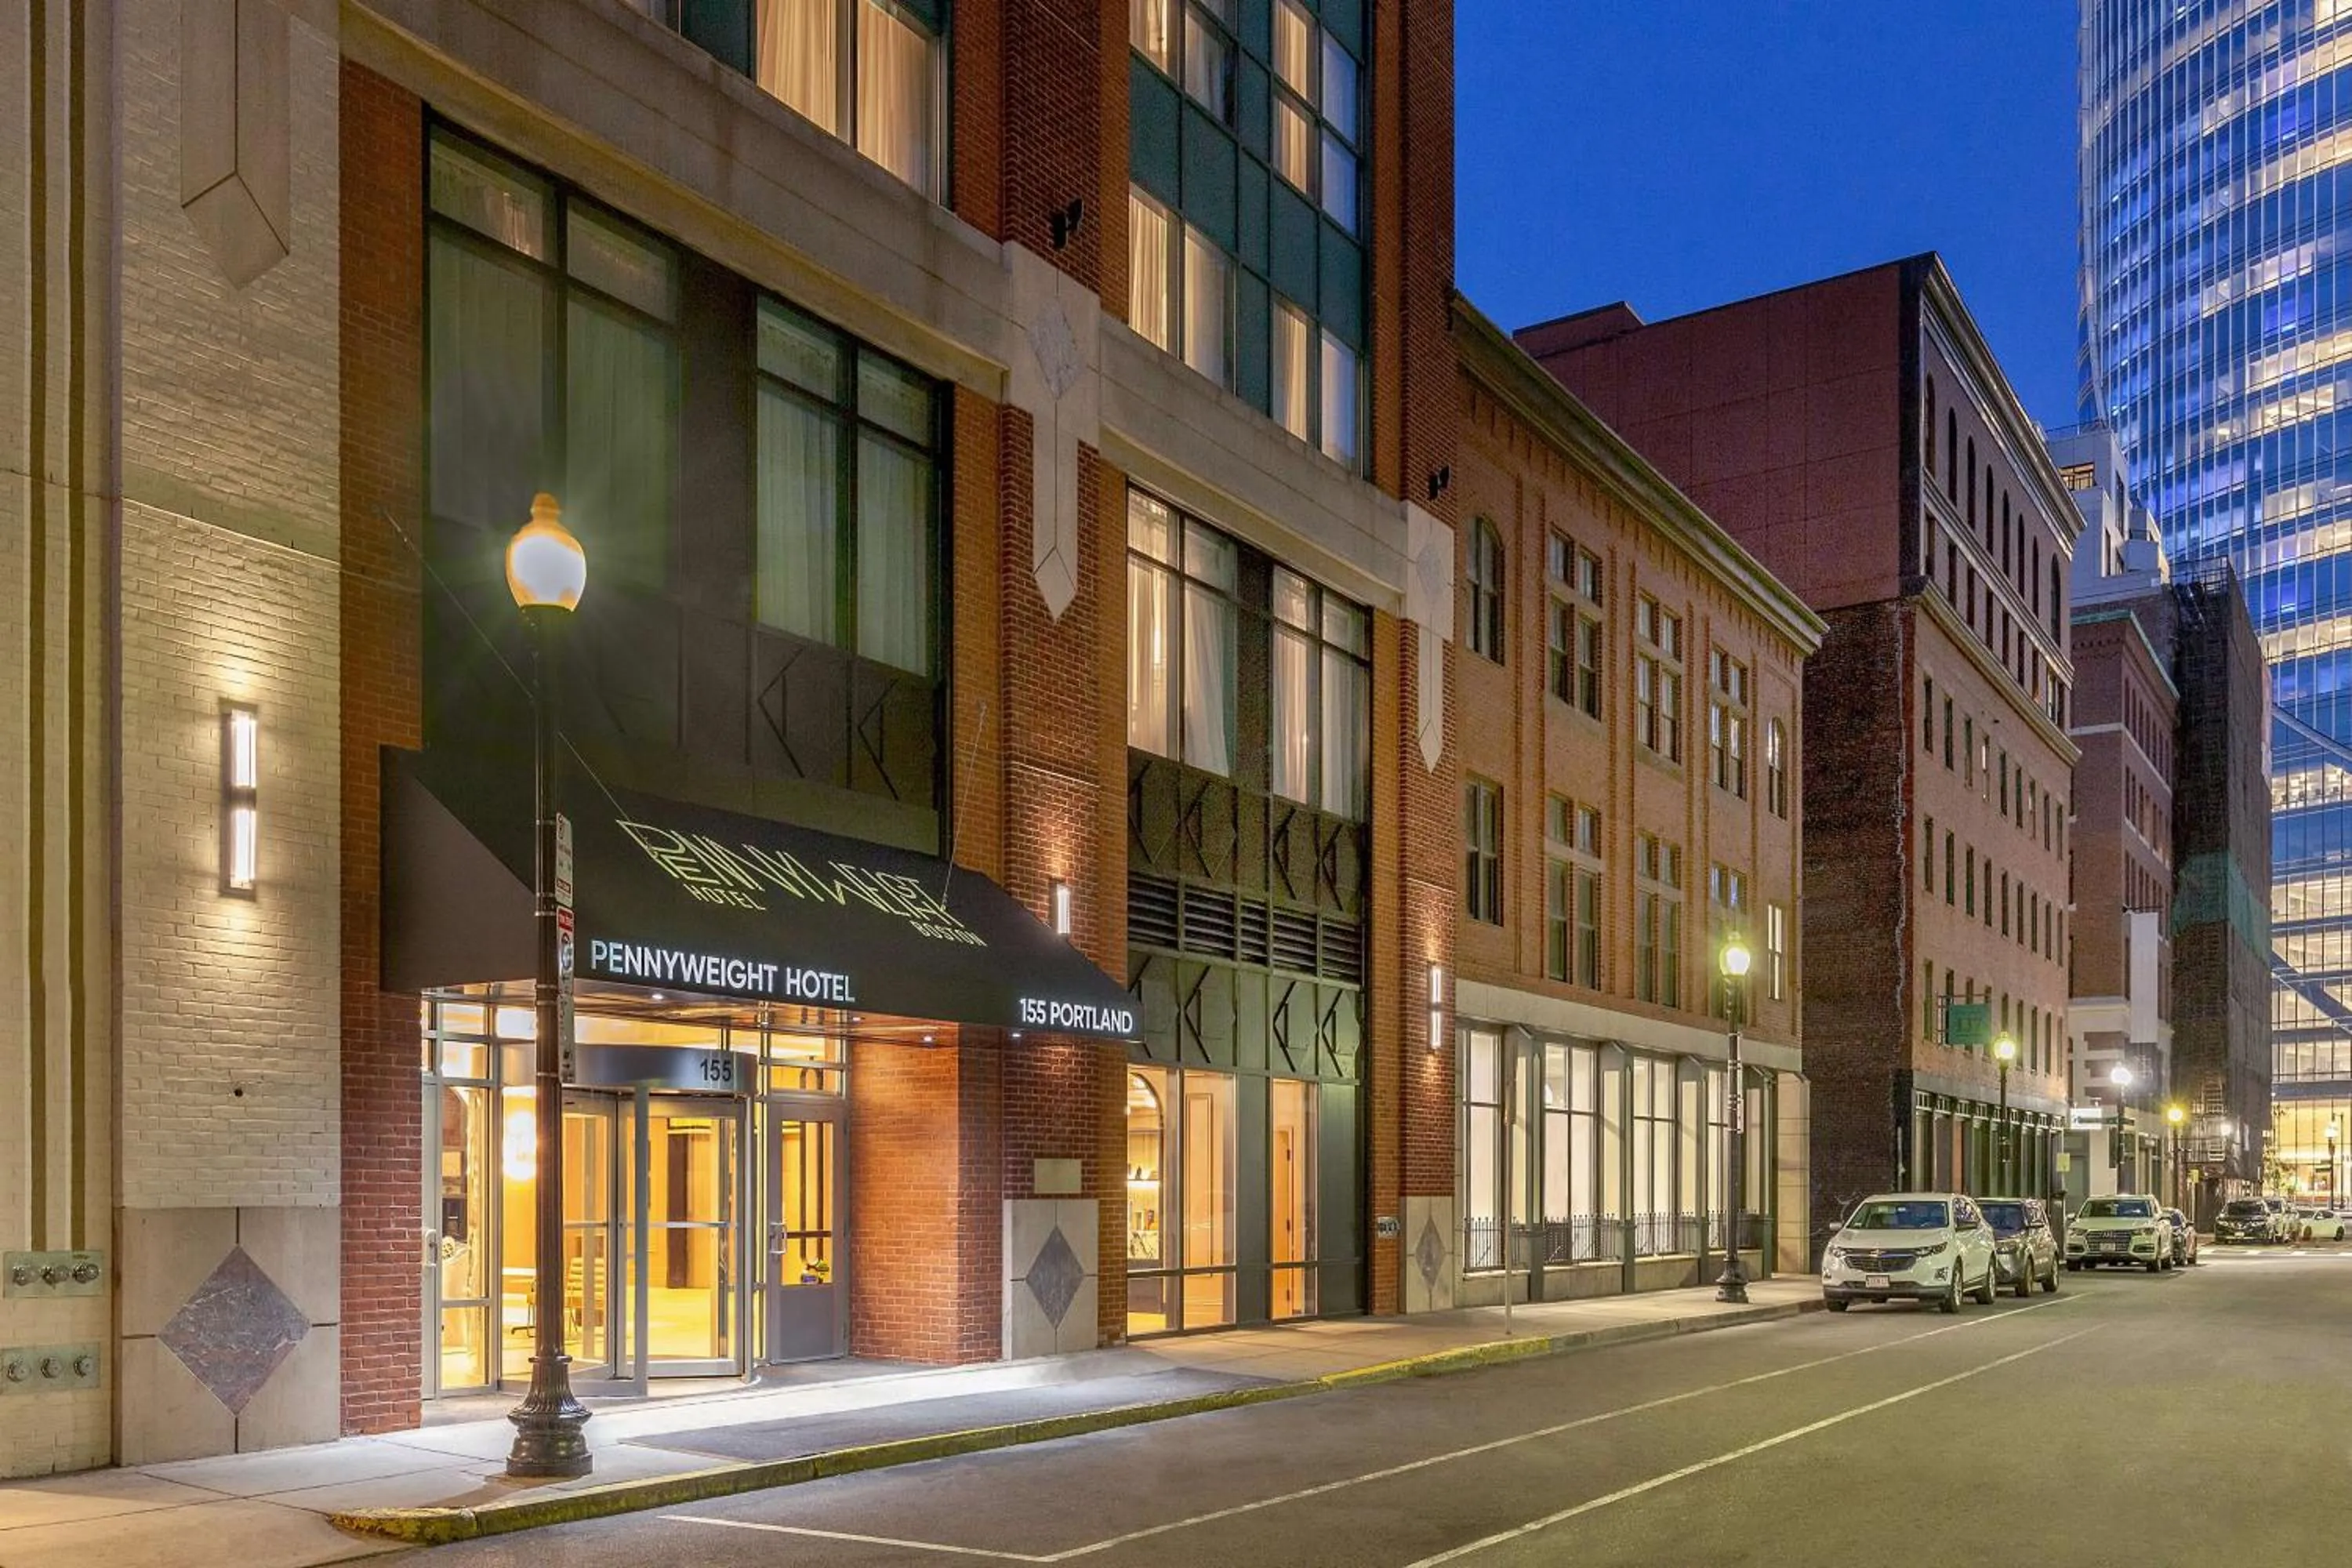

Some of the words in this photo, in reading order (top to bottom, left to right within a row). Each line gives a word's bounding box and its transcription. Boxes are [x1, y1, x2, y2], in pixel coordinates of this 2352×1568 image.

[682, 883, 767, 911] HOTEL
[909, 920, 988, 947] BOSTON
[591, 939, 778, 993] PENNYWEIGHT
[786, 959, 856, 1003] HOTEL
[1020, 998, 1047, 1025] 155
[1050, 1001, 1133, 1033] PORTLAND
[700, 1058, 732, 1082] 155
